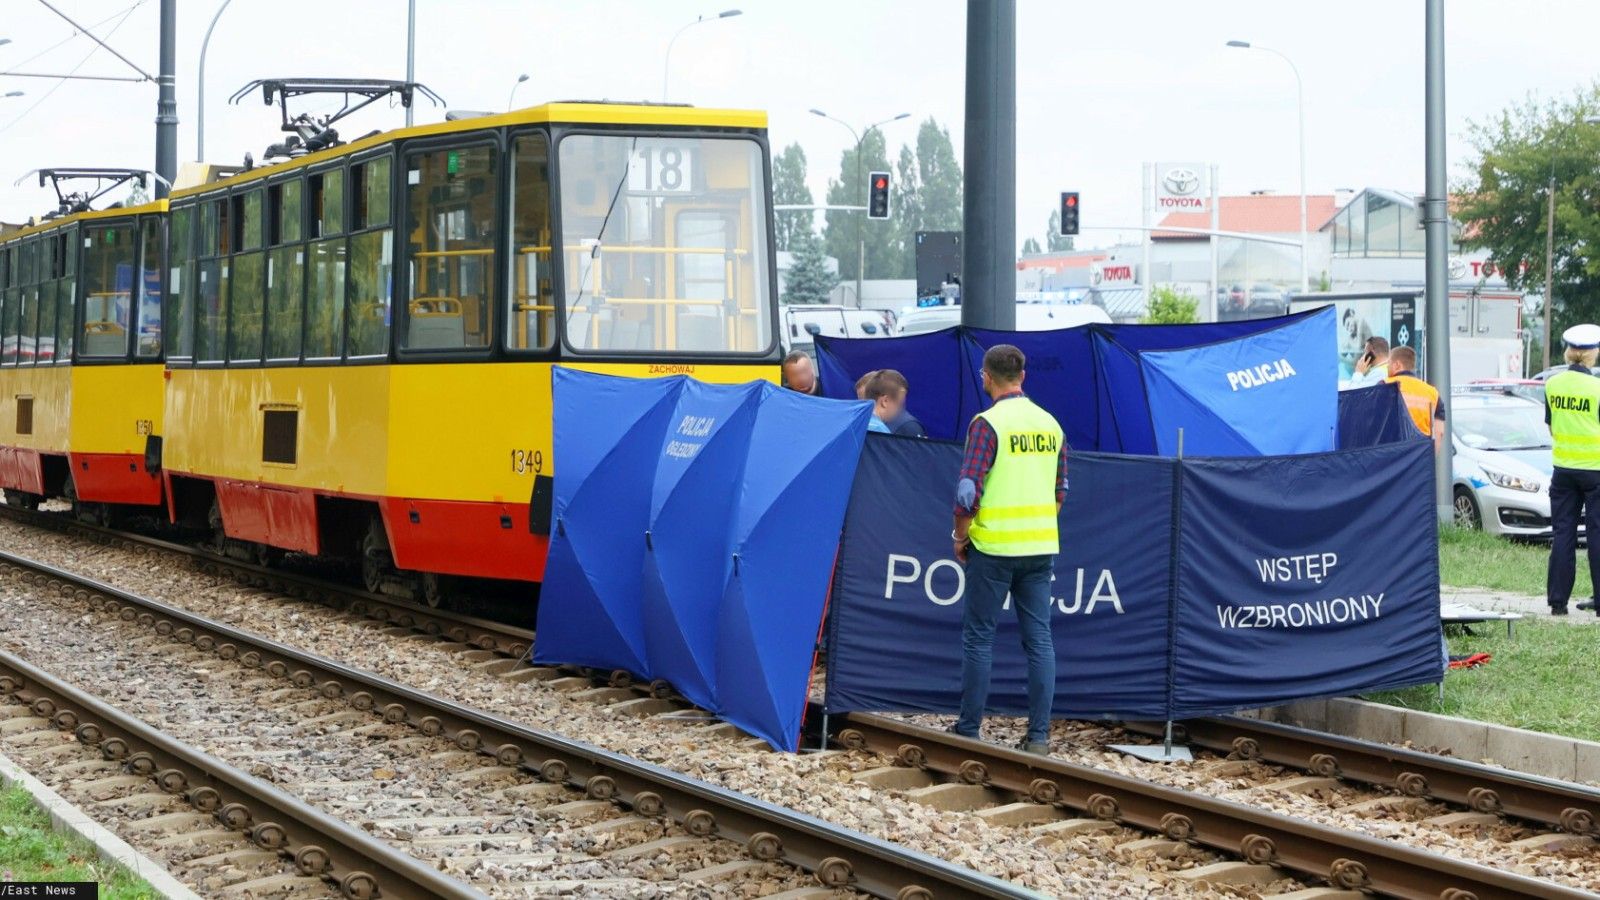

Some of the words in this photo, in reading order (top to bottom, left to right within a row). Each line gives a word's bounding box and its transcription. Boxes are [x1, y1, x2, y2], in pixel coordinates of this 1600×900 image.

[639, 146, 683, 190] 18
[1159, 198, 1203, 207] TOYOTA
[1103, 266, 1132, 281] TOYOTA
[648, 365, 695, 374] ZACHOWAJ
[1226, 359, 1297, 392] POLICJA
[1550, 395, 1591, 412] POLICJA
[676, 415, 715, 437] POLICJA
[1010, 434, 1056, 453] POLICJA
[511, 449, 543, 474] 1349
[1256, 552, 1338, 584] WSTĘP
[884, 553, 1126, 615] POJA
[1216, 592, 1385, 629] WZBRONIONY
